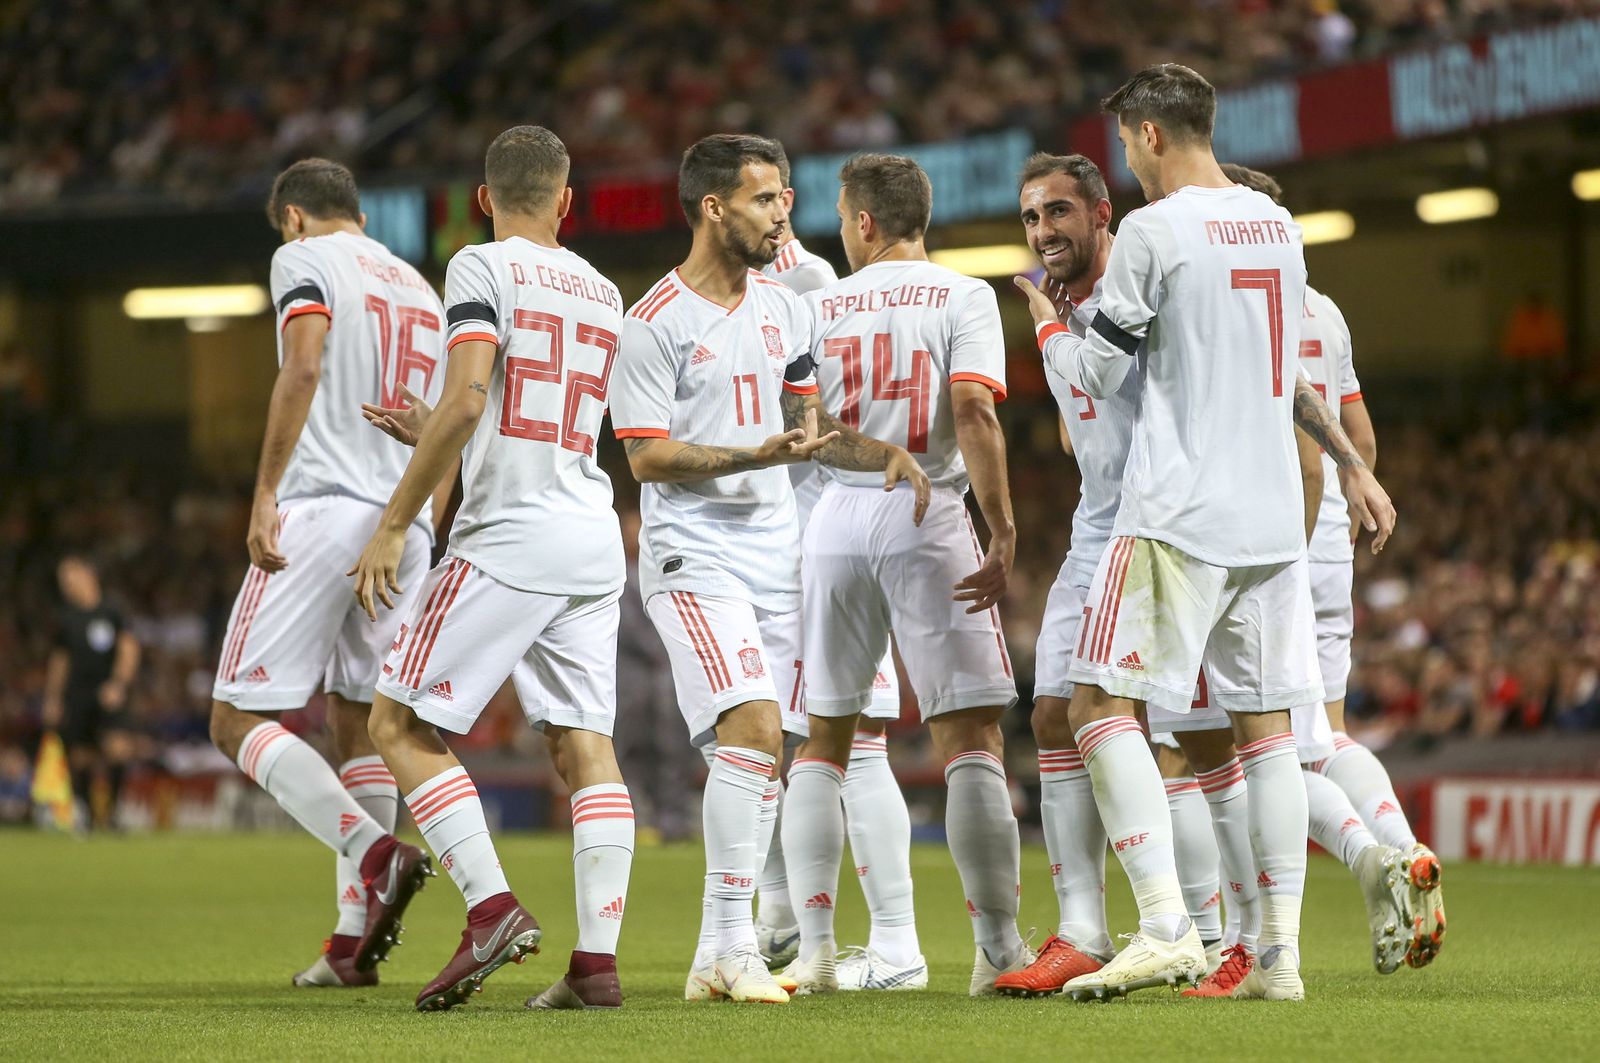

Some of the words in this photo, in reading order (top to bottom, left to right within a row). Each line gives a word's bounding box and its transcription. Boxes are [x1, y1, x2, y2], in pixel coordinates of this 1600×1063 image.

[1204, 220, 1290, 245] MORATA
[510, 262, 532, 285] D.
[536, 264, 618, 312] CEBALLOS
[364, 293, 440, 411] 16
[1230, 268, 1283, 397] 7
[499, 308, 618, 458] 22
[690, 353, 717, 366] adidas
[732, 373, 761, 426] 11
[823, 333, 931, 453] 14
[1116, 660, 1145, 672] adidas
[428, 687, 456, 702] adidas
